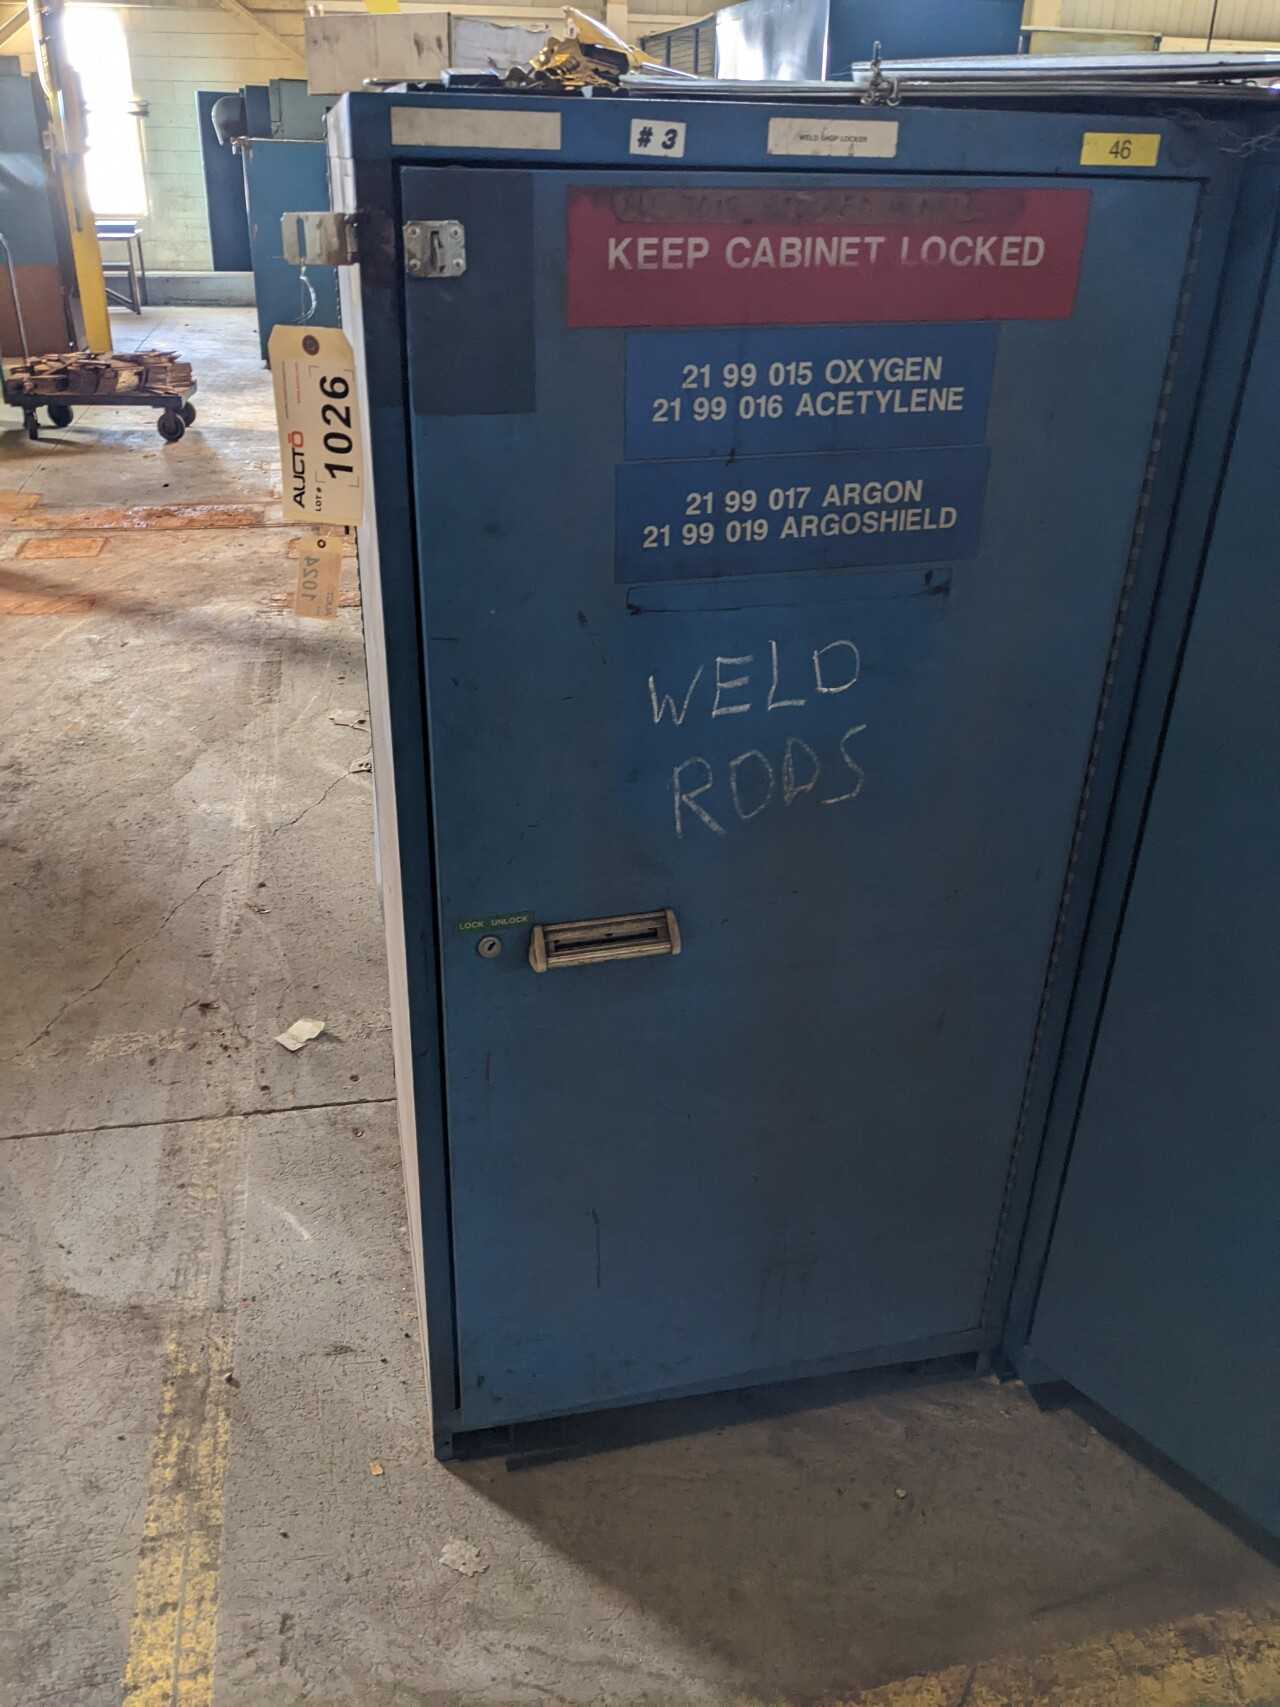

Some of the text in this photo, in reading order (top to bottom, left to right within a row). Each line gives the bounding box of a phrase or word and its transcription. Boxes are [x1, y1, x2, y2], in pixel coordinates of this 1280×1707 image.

[637, 126, 678, 150] # 3
[1109, 139, 1132, 159] 46
[607, 234, 1046, 271] KEEP CABINET LOCKED
[682, 356, 943, 389] 21 99 015 OXYGEN
[652, 386, 965, 422] 21 99 016 ACETYLENE
[319, 375, 354, 480] 1026
[685, 479, 924, 516] 21 99 017 ARGON
[642, 506, 957, 548] 21 99 019 ARGOSHIELD
[649, 640, 861, 726] WELD
[672, 724, 867, 839] RODS
[458, 915, 528, 931] LOCK UNLOCK
